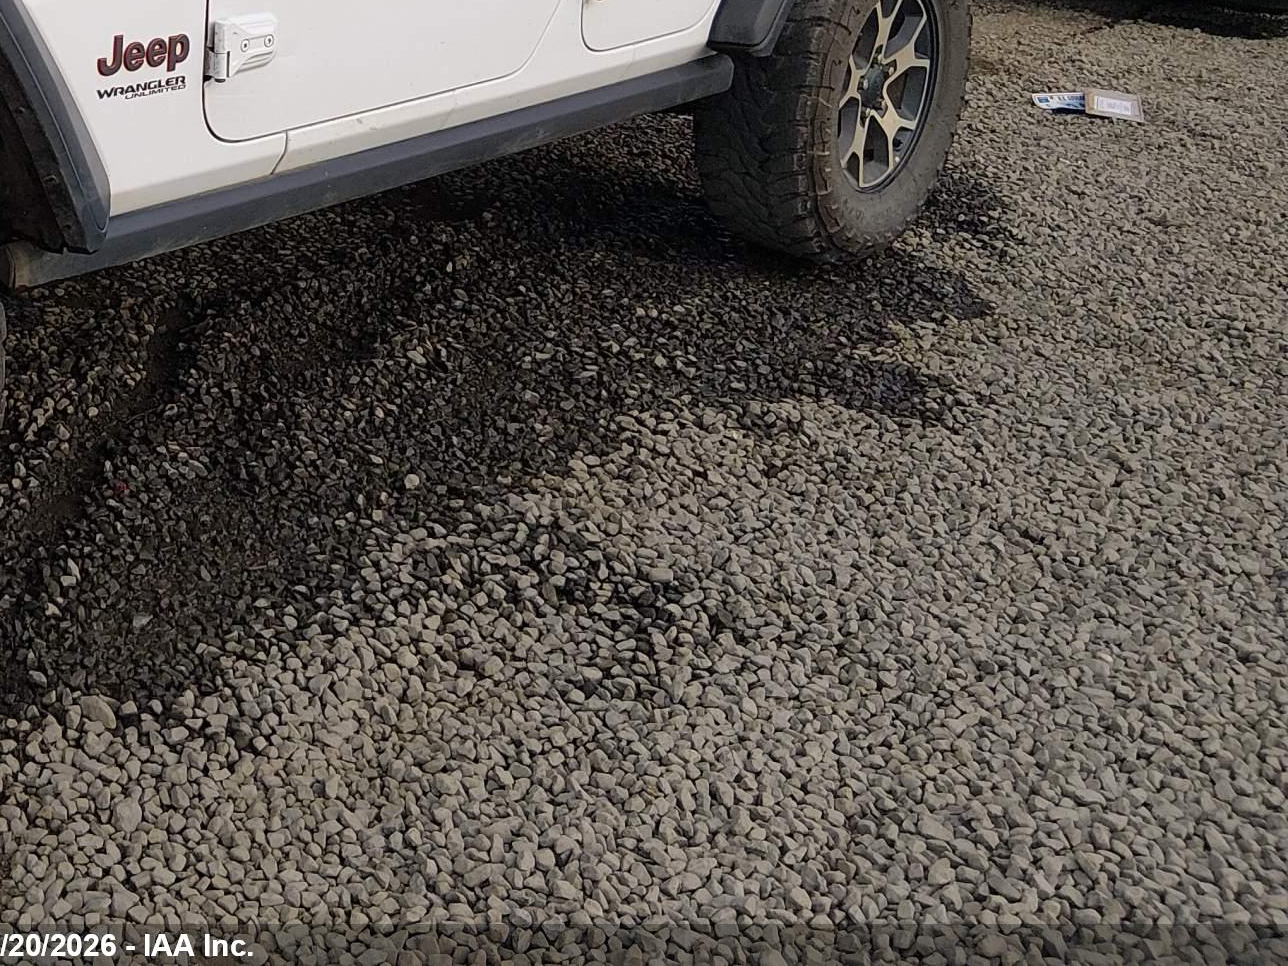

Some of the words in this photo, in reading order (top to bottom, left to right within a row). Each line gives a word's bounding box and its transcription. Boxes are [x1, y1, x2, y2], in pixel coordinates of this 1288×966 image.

[97, 33, 190, 76] Jeep
[96, 75, 187, 99] WRANGLER
[124, 84, 187, 100] UNLIMITED
